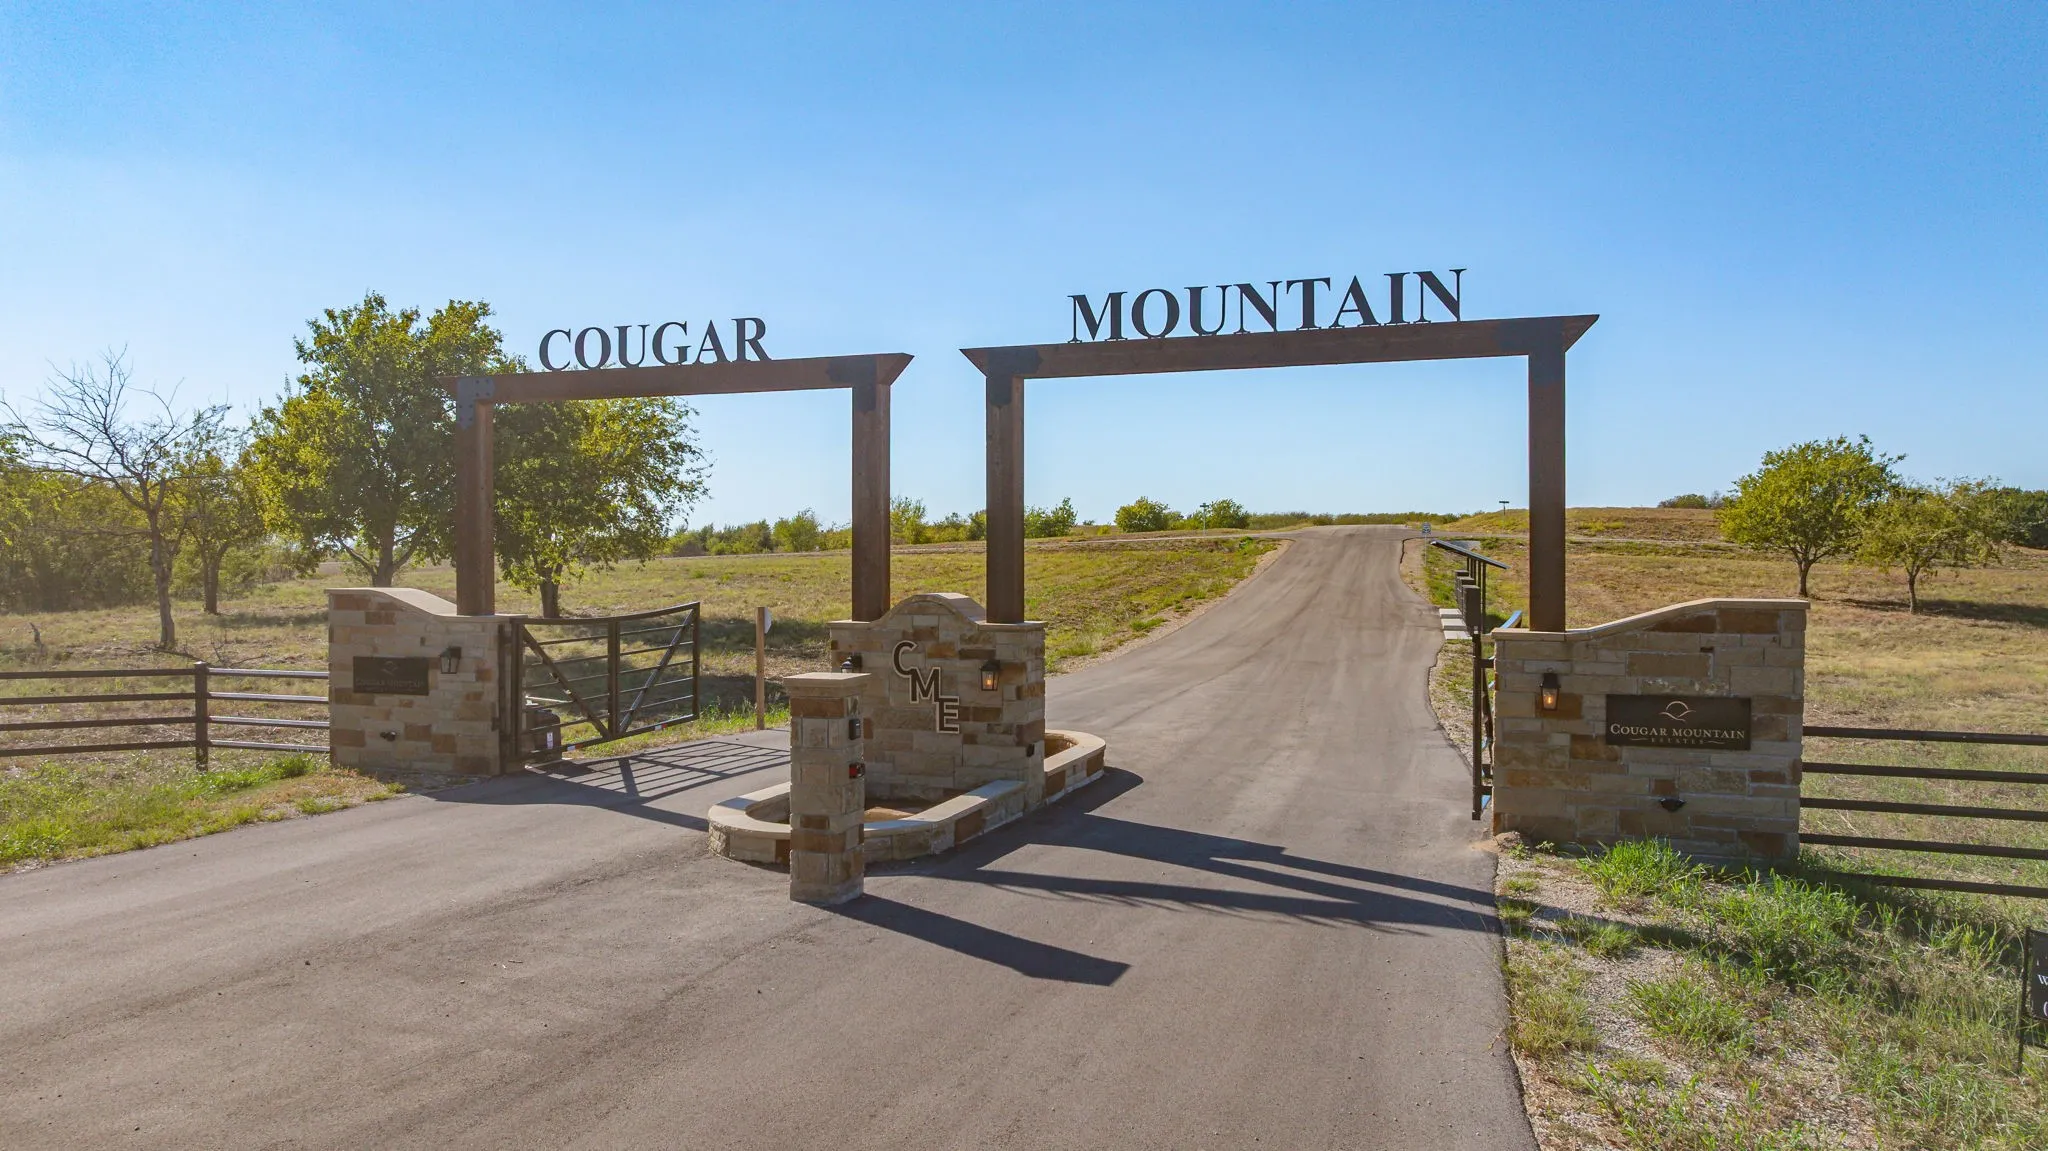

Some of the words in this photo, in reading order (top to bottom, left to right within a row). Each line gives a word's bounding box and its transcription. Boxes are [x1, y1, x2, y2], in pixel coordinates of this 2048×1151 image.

[539, 317, 772, 372] COUGAR
[1067, 268, 1467, 344] MOUNTAIN
[1672, 727, 1745, 739] MOUNTAIN
